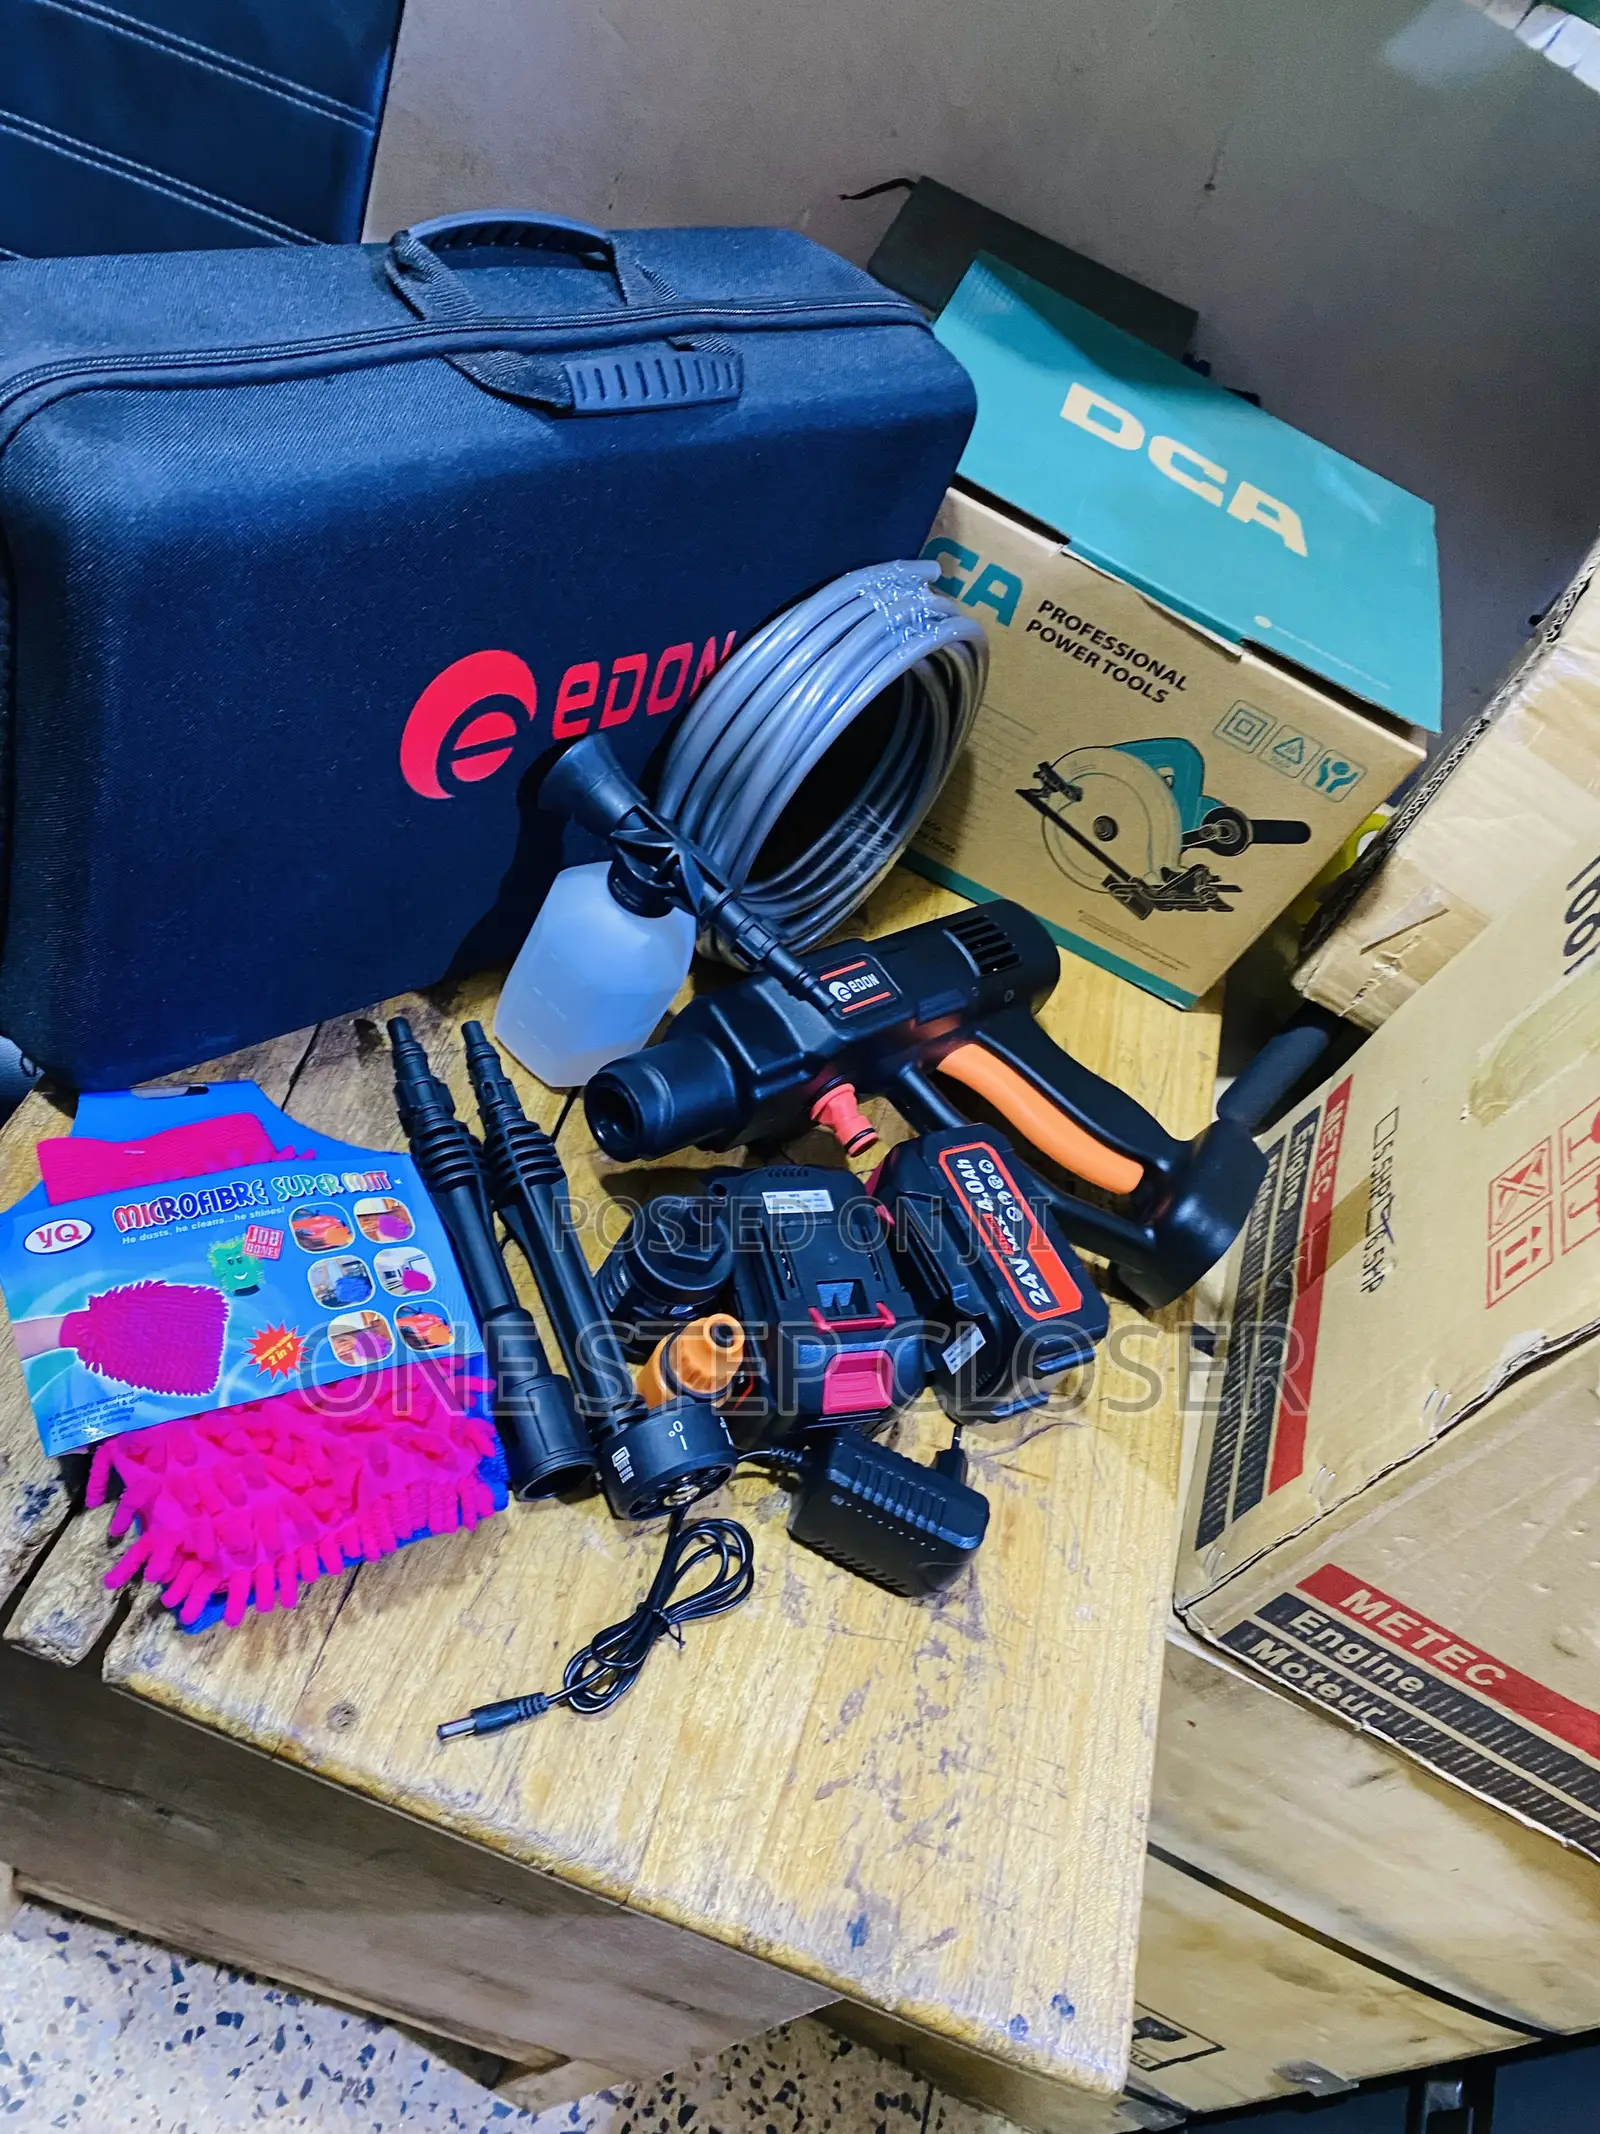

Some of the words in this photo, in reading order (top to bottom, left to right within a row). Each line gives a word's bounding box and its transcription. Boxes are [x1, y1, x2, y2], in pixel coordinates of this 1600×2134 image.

[1059, 382, 1308, 557] DCA
[917, 536, 1024, 628] CA
[1025, 619, 1101, 668] POWER
[1101, 659, 1170, 703] TOOLS
[1037, 600, 1187, 692] PROFESSIONAL
[956, 1158, 995, 1212] 4.0Ah
[1283, 1121, 1316, 1211] Engine
[1312, 1099, 1345, 1204] METEC
[1369, 1138, 1395, 1199] 5.5HP
[112, 1178, 271, 1233] MICROFIBRE
[271, 1173, 345, 1202] SUPER
[122, 1236, 137, 1245] He
[175, 1225, 188, 1233] he
[993, 1213, 1021, 1252] MAX
[1008, 1257, 1052, 1306] 24V
[1247, 1637, 1388, 1721] Moteur
[1288, 1609, 1426, 1694] Engine
[1339, 1587, 1508, 1688] METEC
